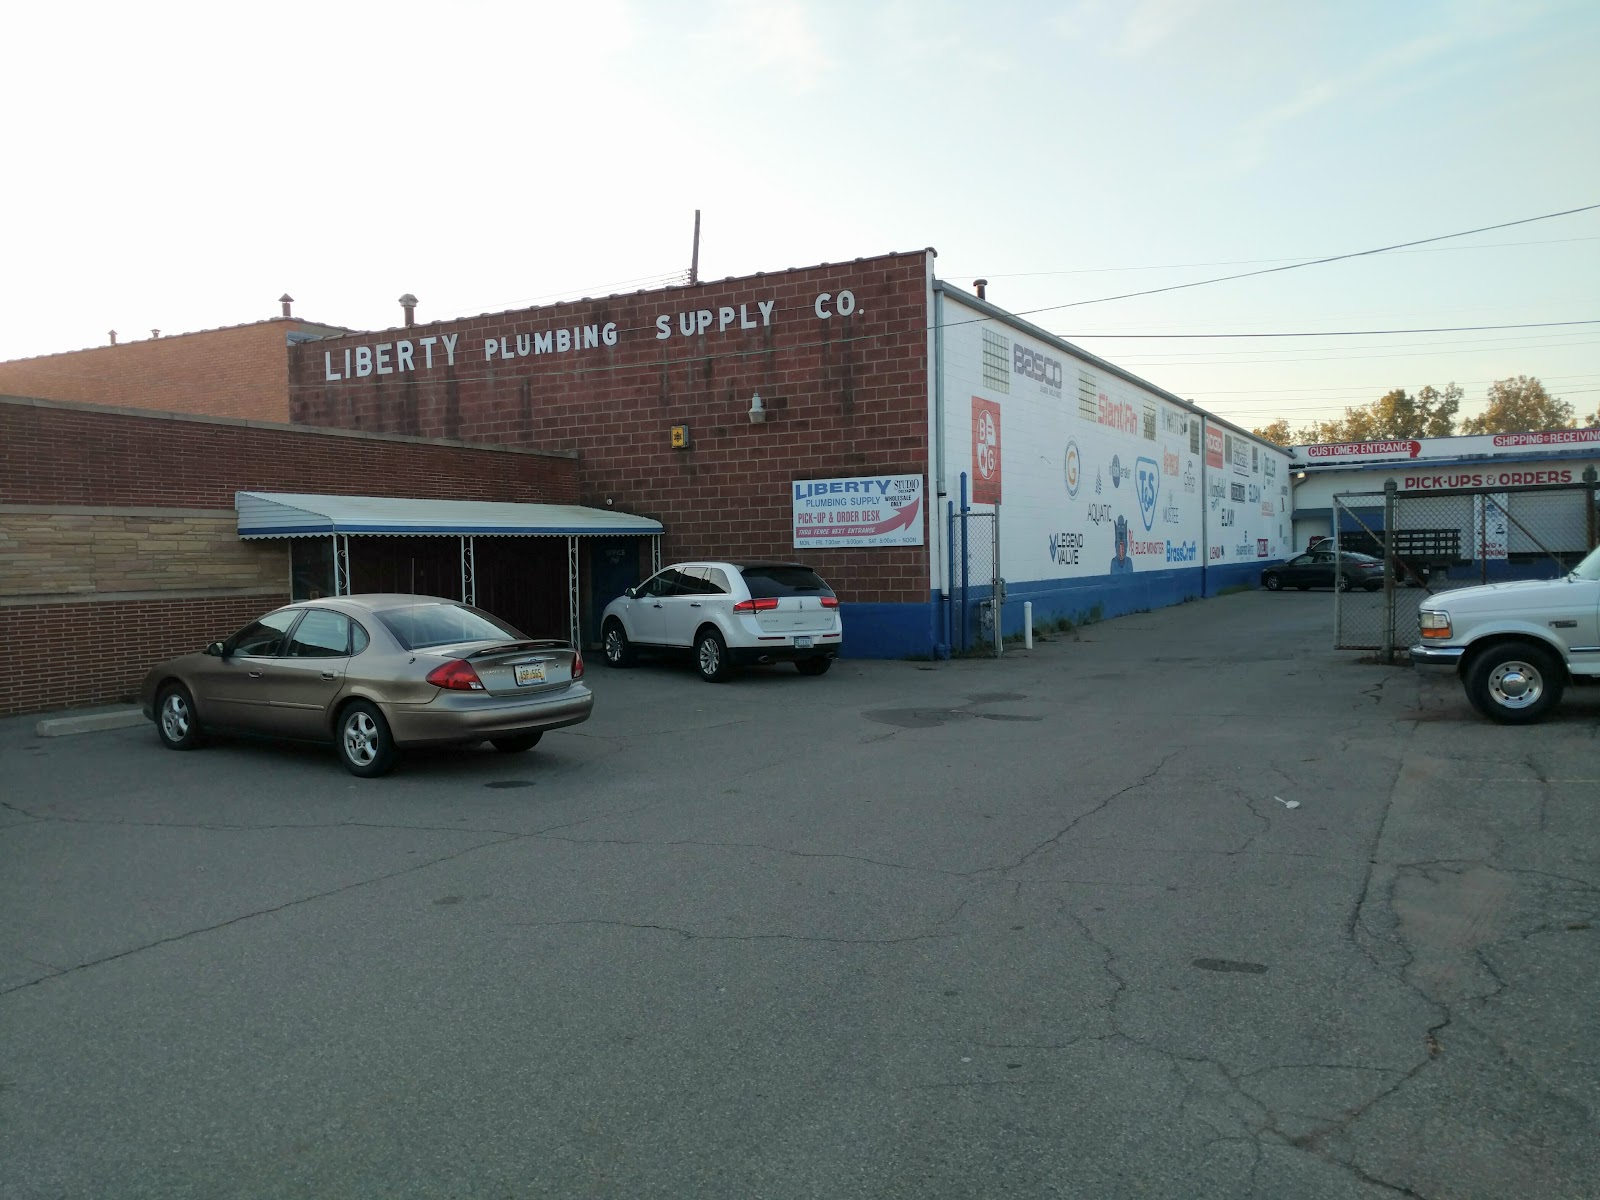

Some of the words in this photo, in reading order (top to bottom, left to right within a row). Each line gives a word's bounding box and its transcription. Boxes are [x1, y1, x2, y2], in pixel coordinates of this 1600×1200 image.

[324, 333, 458, 381] LIBERTY
[484, 322, 618, 361] PLUMBING
[655, 300, 774, 339] SUPPLY
[814, 290, 865, 319] CO.
[1495, 434, 1543, 446] SHIPPING
[1310, 445, 1359, 456] CUSTOMER
[1361, 442, 1413, 453] ENTRANCE
[894, 479, 920, 490] STUDIO
[1405, 474, 1483, 489] PICK-UPS
[1486, 475, 1497, 485] &
[1499, 470, 1572, 485] ORDERS
[795, 480, 891, 500] LIBERTY
[806, 497, 847, 508] PLUMBING
[850, 496, 881, 506] SUPPLY
[798, 512, 826, 524] PICK-UP
[828, 512, 834, 523] &
[836, 511, 859, 522] ORDER
[861, 510, 881, 521] DESK
[1087, 503, 1112, 525] AQUATIC
[1056, 533, 1083, 548] LEGEND
[1135, 542, 1146, 554] BLUE
[1147, 542, 1164, 554] MONSTER
[1057, 549, 1079, 565] VALVE
[1166, 540, 1197, 562] BrassCraft
